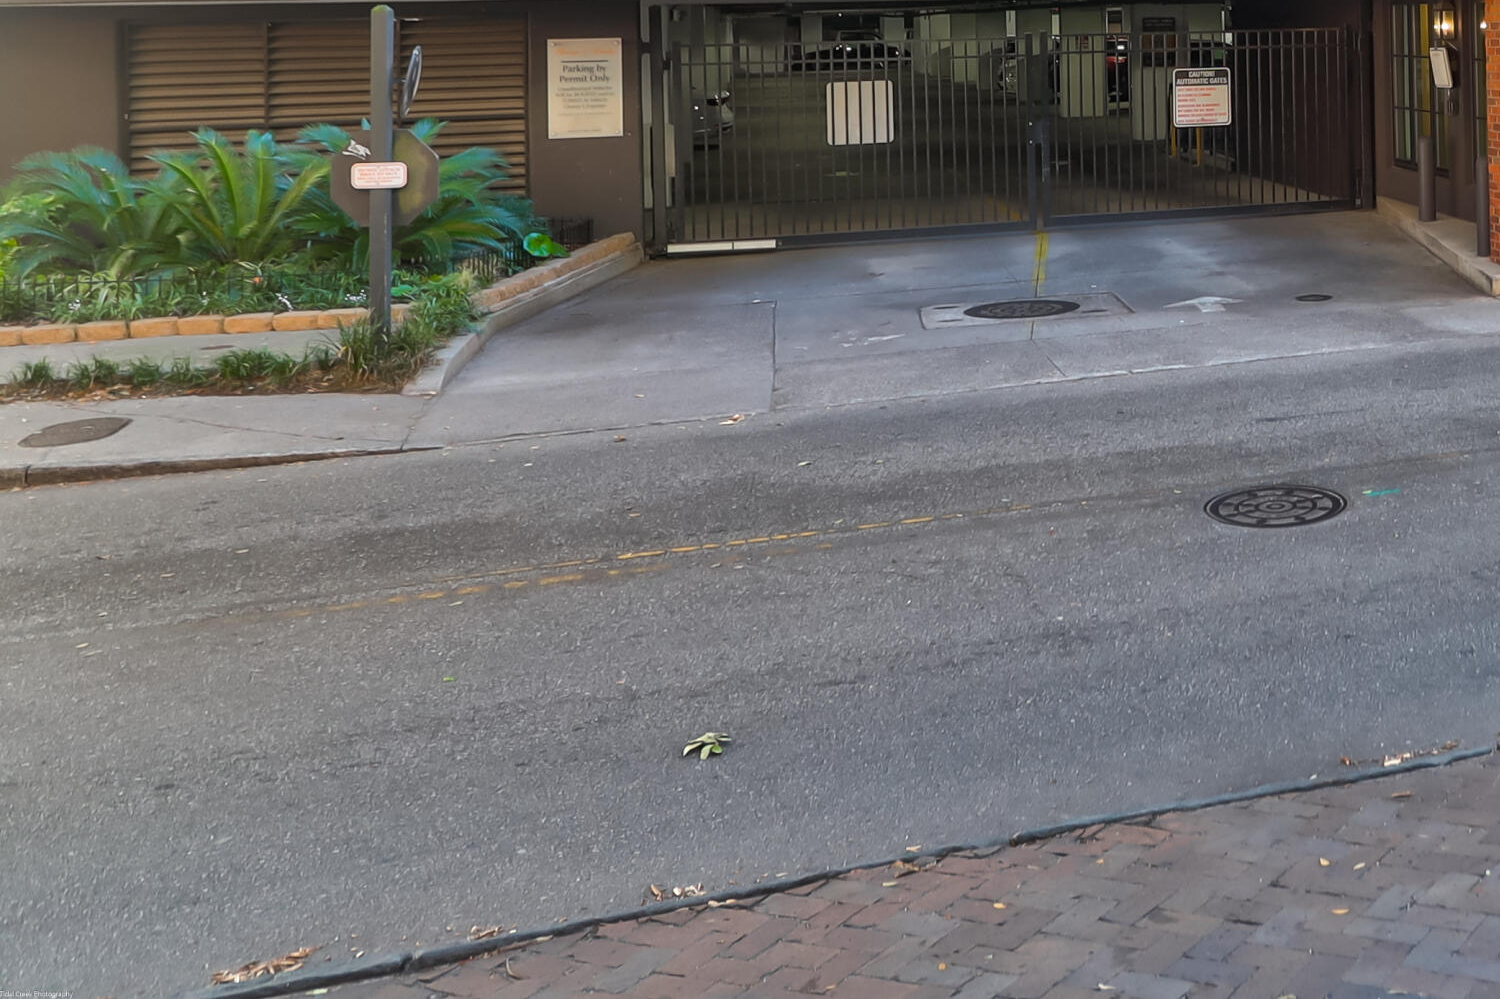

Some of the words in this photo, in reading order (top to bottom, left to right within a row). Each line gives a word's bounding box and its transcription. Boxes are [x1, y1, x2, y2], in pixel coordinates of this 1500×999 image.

[562, 64, 595, 74] Parking
[596, 63, 607, 73] by
[559, 74, 587, 83] Permit
[590, 73, 610, 84] Only
[1209, 76, 1228, 84] GATES
